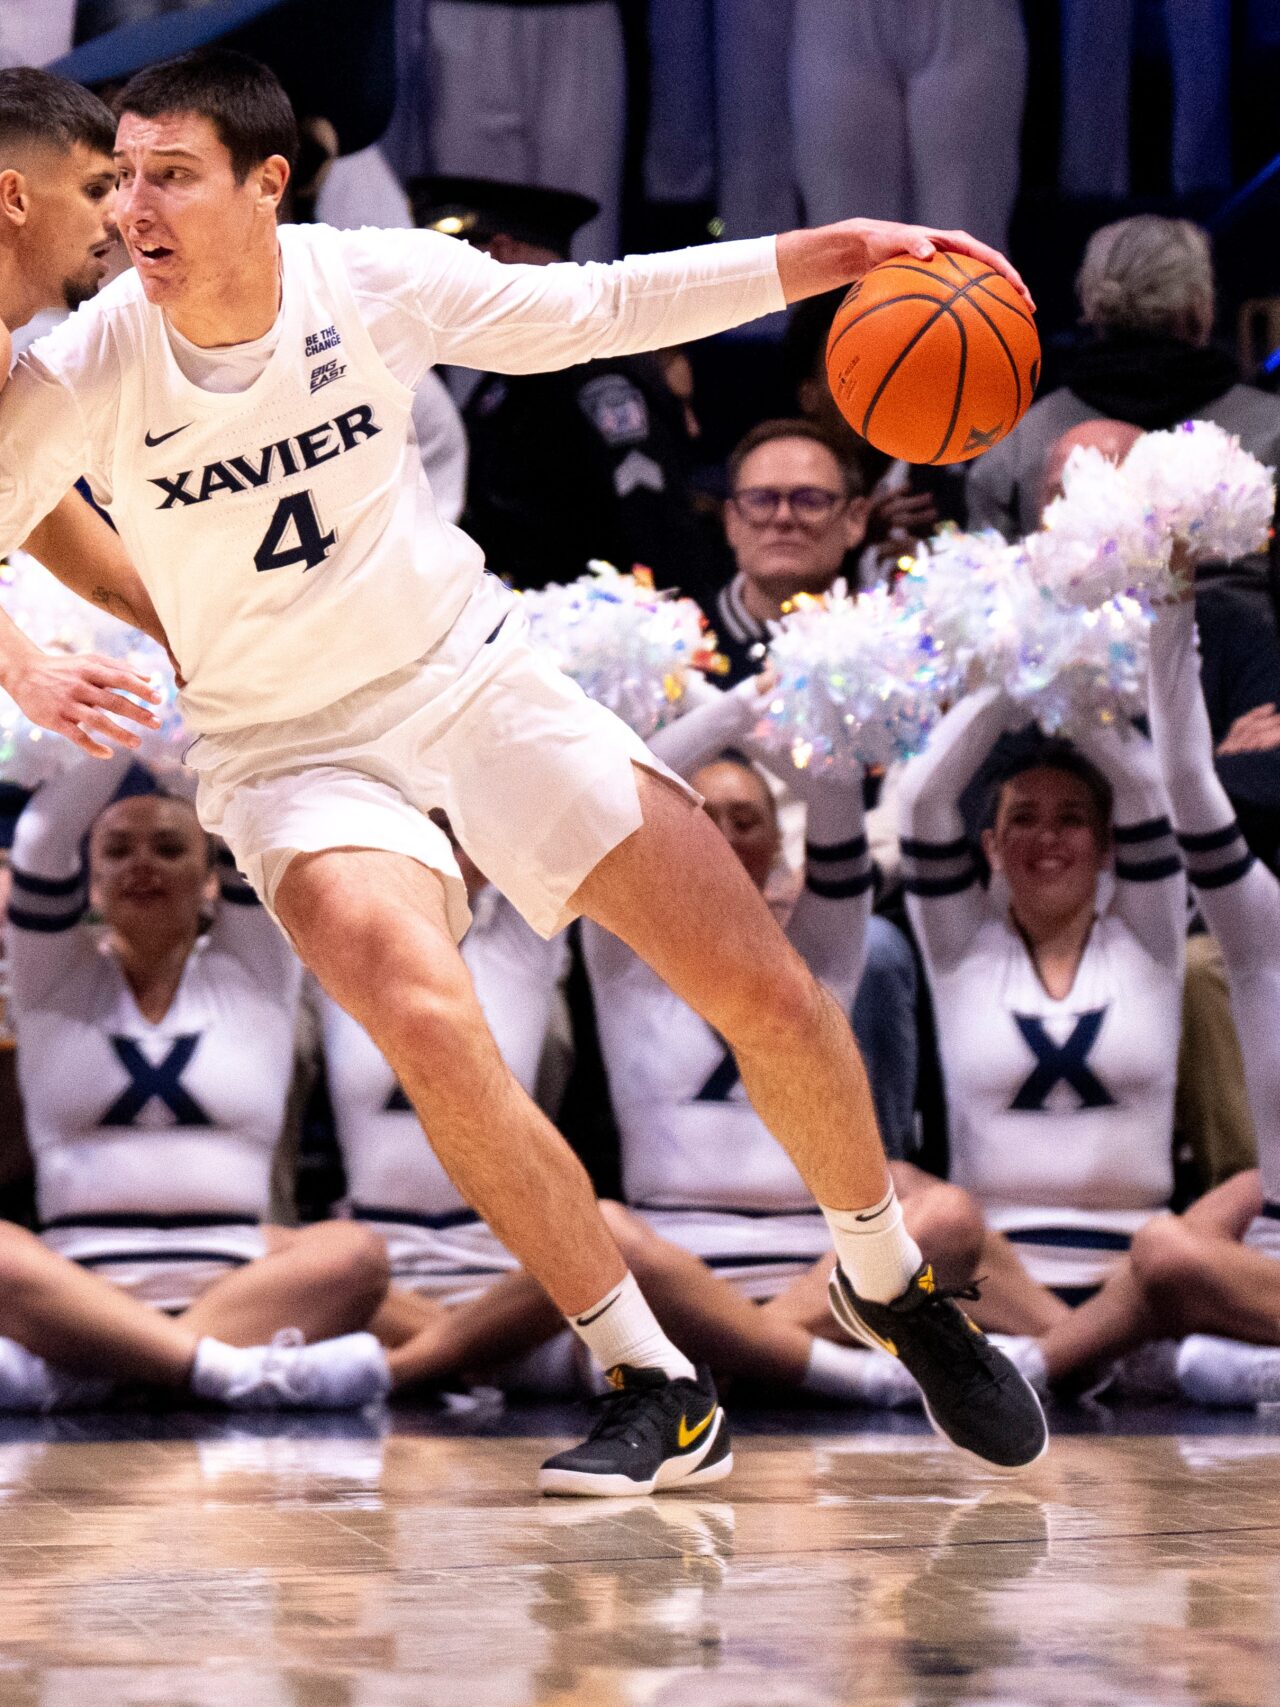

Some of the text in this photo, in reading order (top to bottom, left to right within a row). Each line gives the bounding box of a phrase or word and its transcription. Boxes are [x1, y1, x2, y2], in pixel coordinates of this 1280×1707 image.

[305, 325, 337, 346] BE THE
[305, 334, 341, 357] CHANGE
[310, 365, 347, 389] EAST
[311, 358, 338, 379] BIG
[146, 403, 383, 510] XAVIER
[253, 489, 339, 573] 4
[98, 1033, 213, 1126] X
[1007, 1005, 1119, 1110] X
